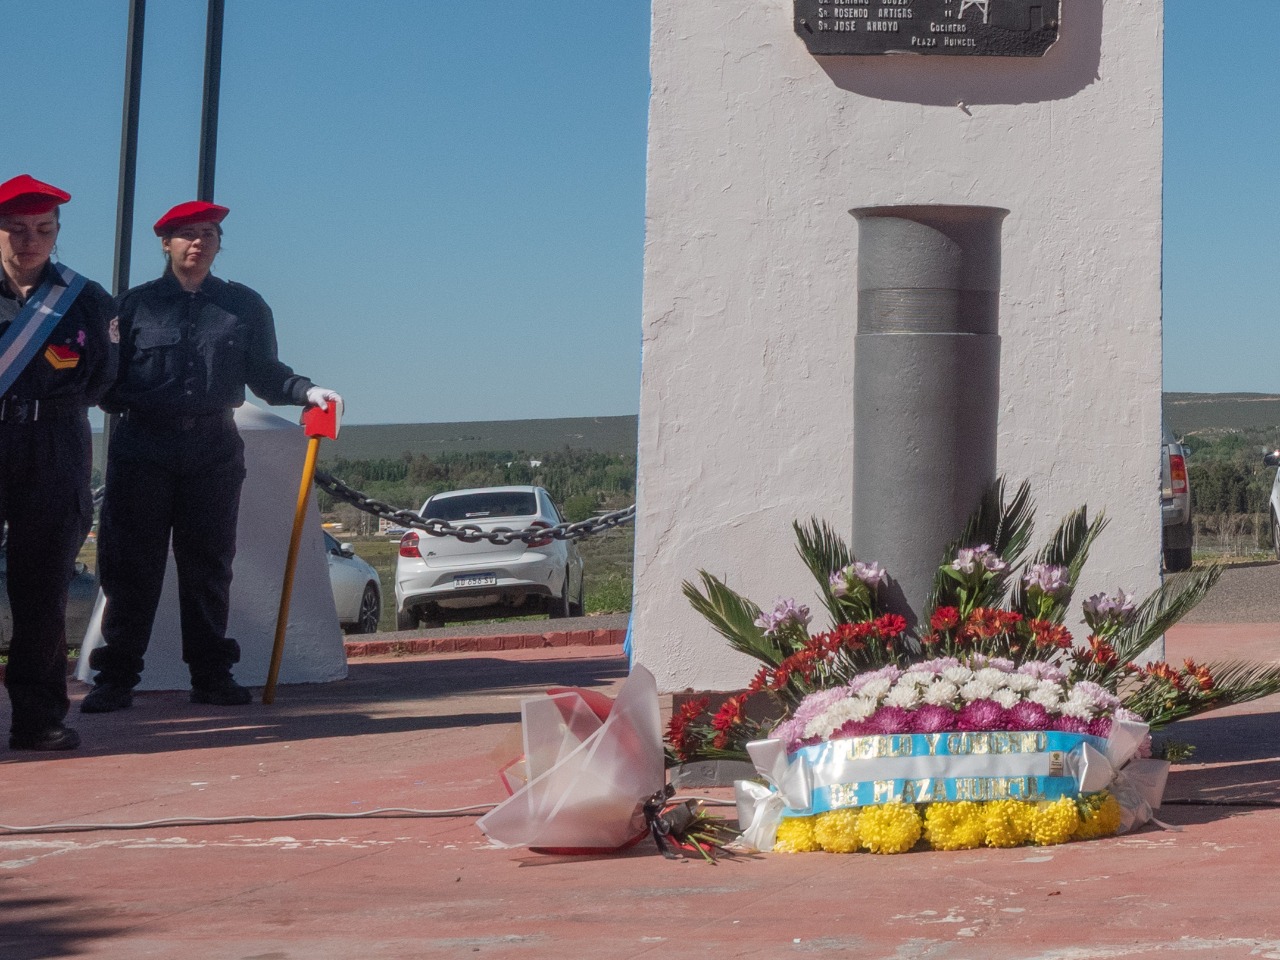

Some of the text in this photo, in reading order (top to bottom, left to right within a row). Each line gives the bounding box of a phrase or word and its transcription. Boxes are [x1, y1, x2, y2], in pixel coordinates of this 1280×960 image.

[833, 731, 1047, 760] PUEBLO Y GOBIERNO
[830, 777, 1046, 809] DE PLAZA HUINCUL
